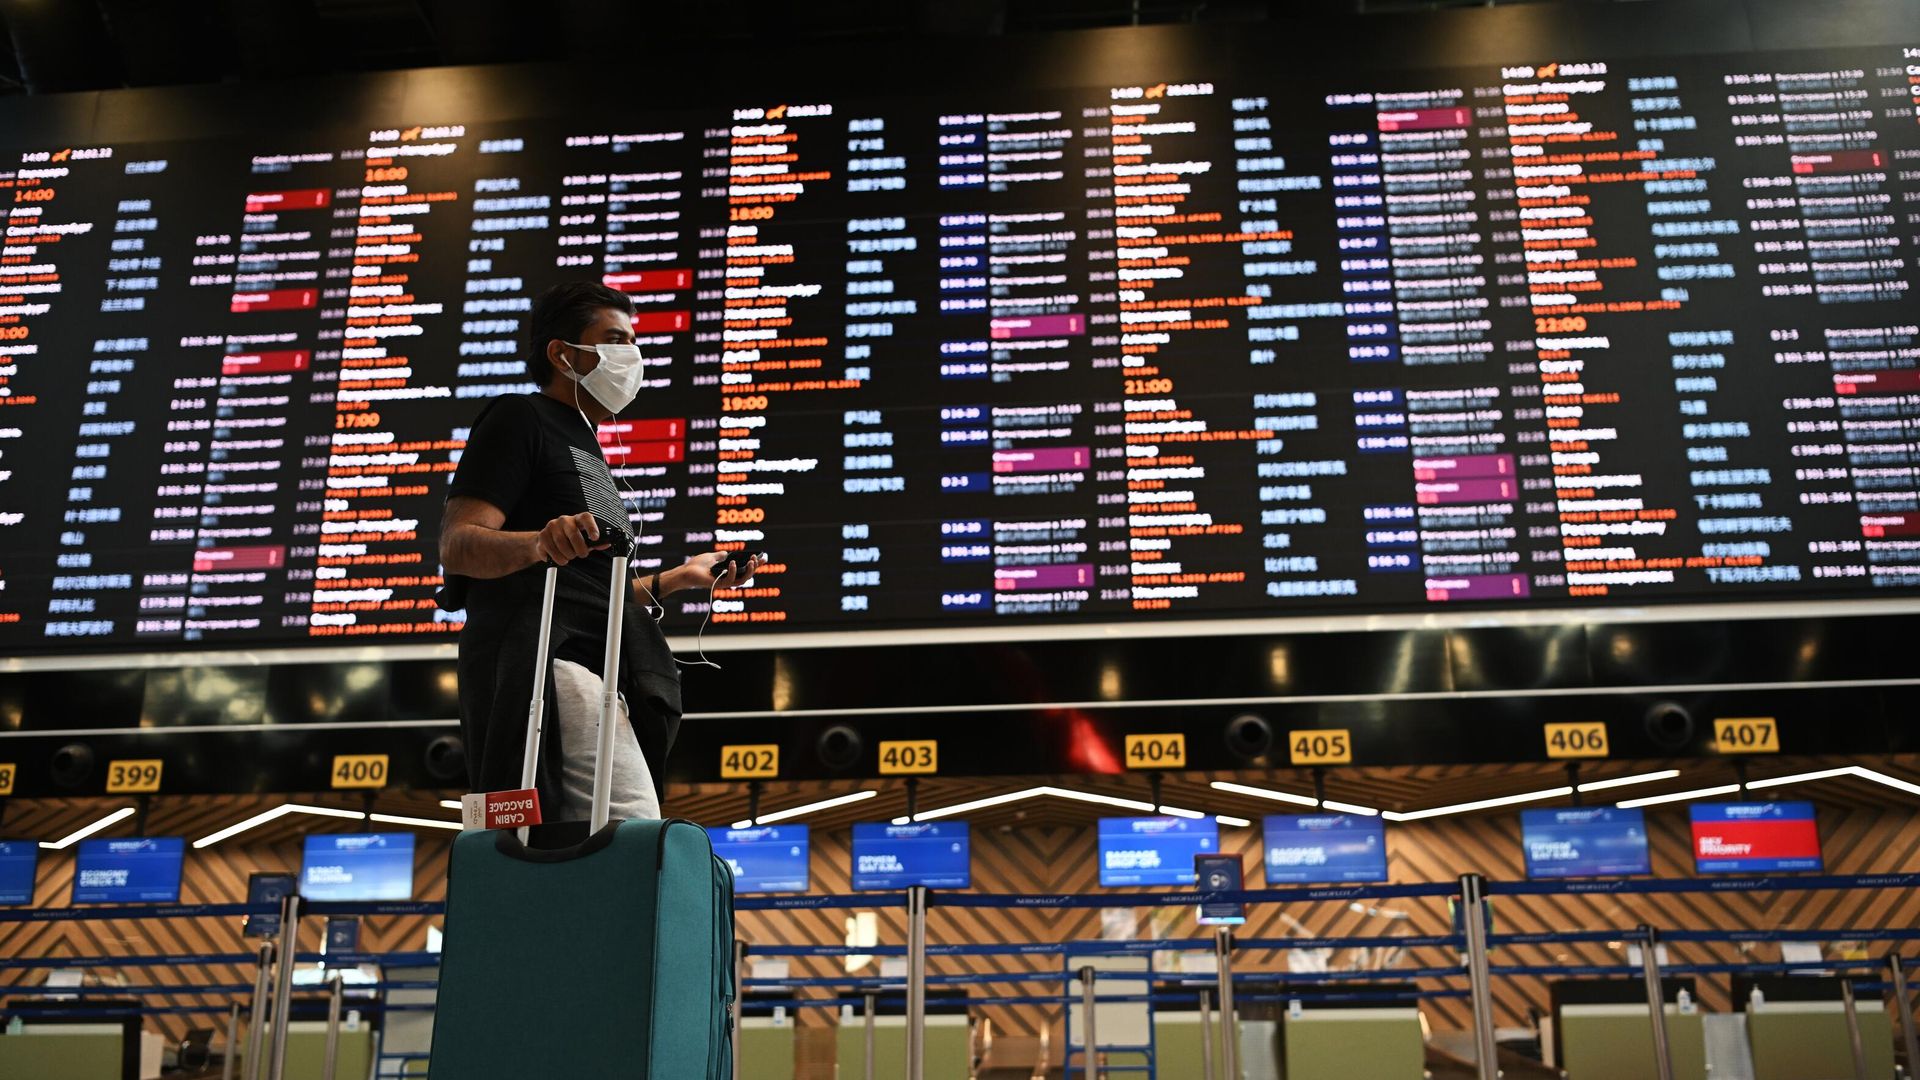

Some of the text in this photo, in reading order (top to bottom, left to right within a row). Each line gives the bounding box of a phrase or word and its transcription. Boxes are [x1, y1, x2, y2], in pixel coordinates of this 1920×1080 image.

[365, 167, 408, 182] 16:00
[15, 189, 54, 202] 14:00
[730, 206, 773, 221] 18:00
[1535, 316, 1587, 333] 22:00
[1125, 378, 1173, 394] 21:00
[722, 396, 768, 411] 19:00
[335, 412, 380, 428] 17:00
[718, 508, 765, 524] 20:00
[1550, 729, 1603, 750] 406
[1721, 724, 1772, 746] 407
[1130, 740, 1181, 761] 404
[1295, 736, 1346, 757] 405
[725, 752, 774, 771] 402
[883, 747, 932, 767] 403
[111, 766, 158, 787] 399
[336, 761, 383, 781] 400
[489, 799, 533, 812] BAGGAGE
[496, 813, 525, 825] CABIN
[1016, 895, 1057, 904] AEROFLOT
[1161, 893, 1202, 903] AEROFLOT
[1309, 889, 1351, 899] AEROFLOT
